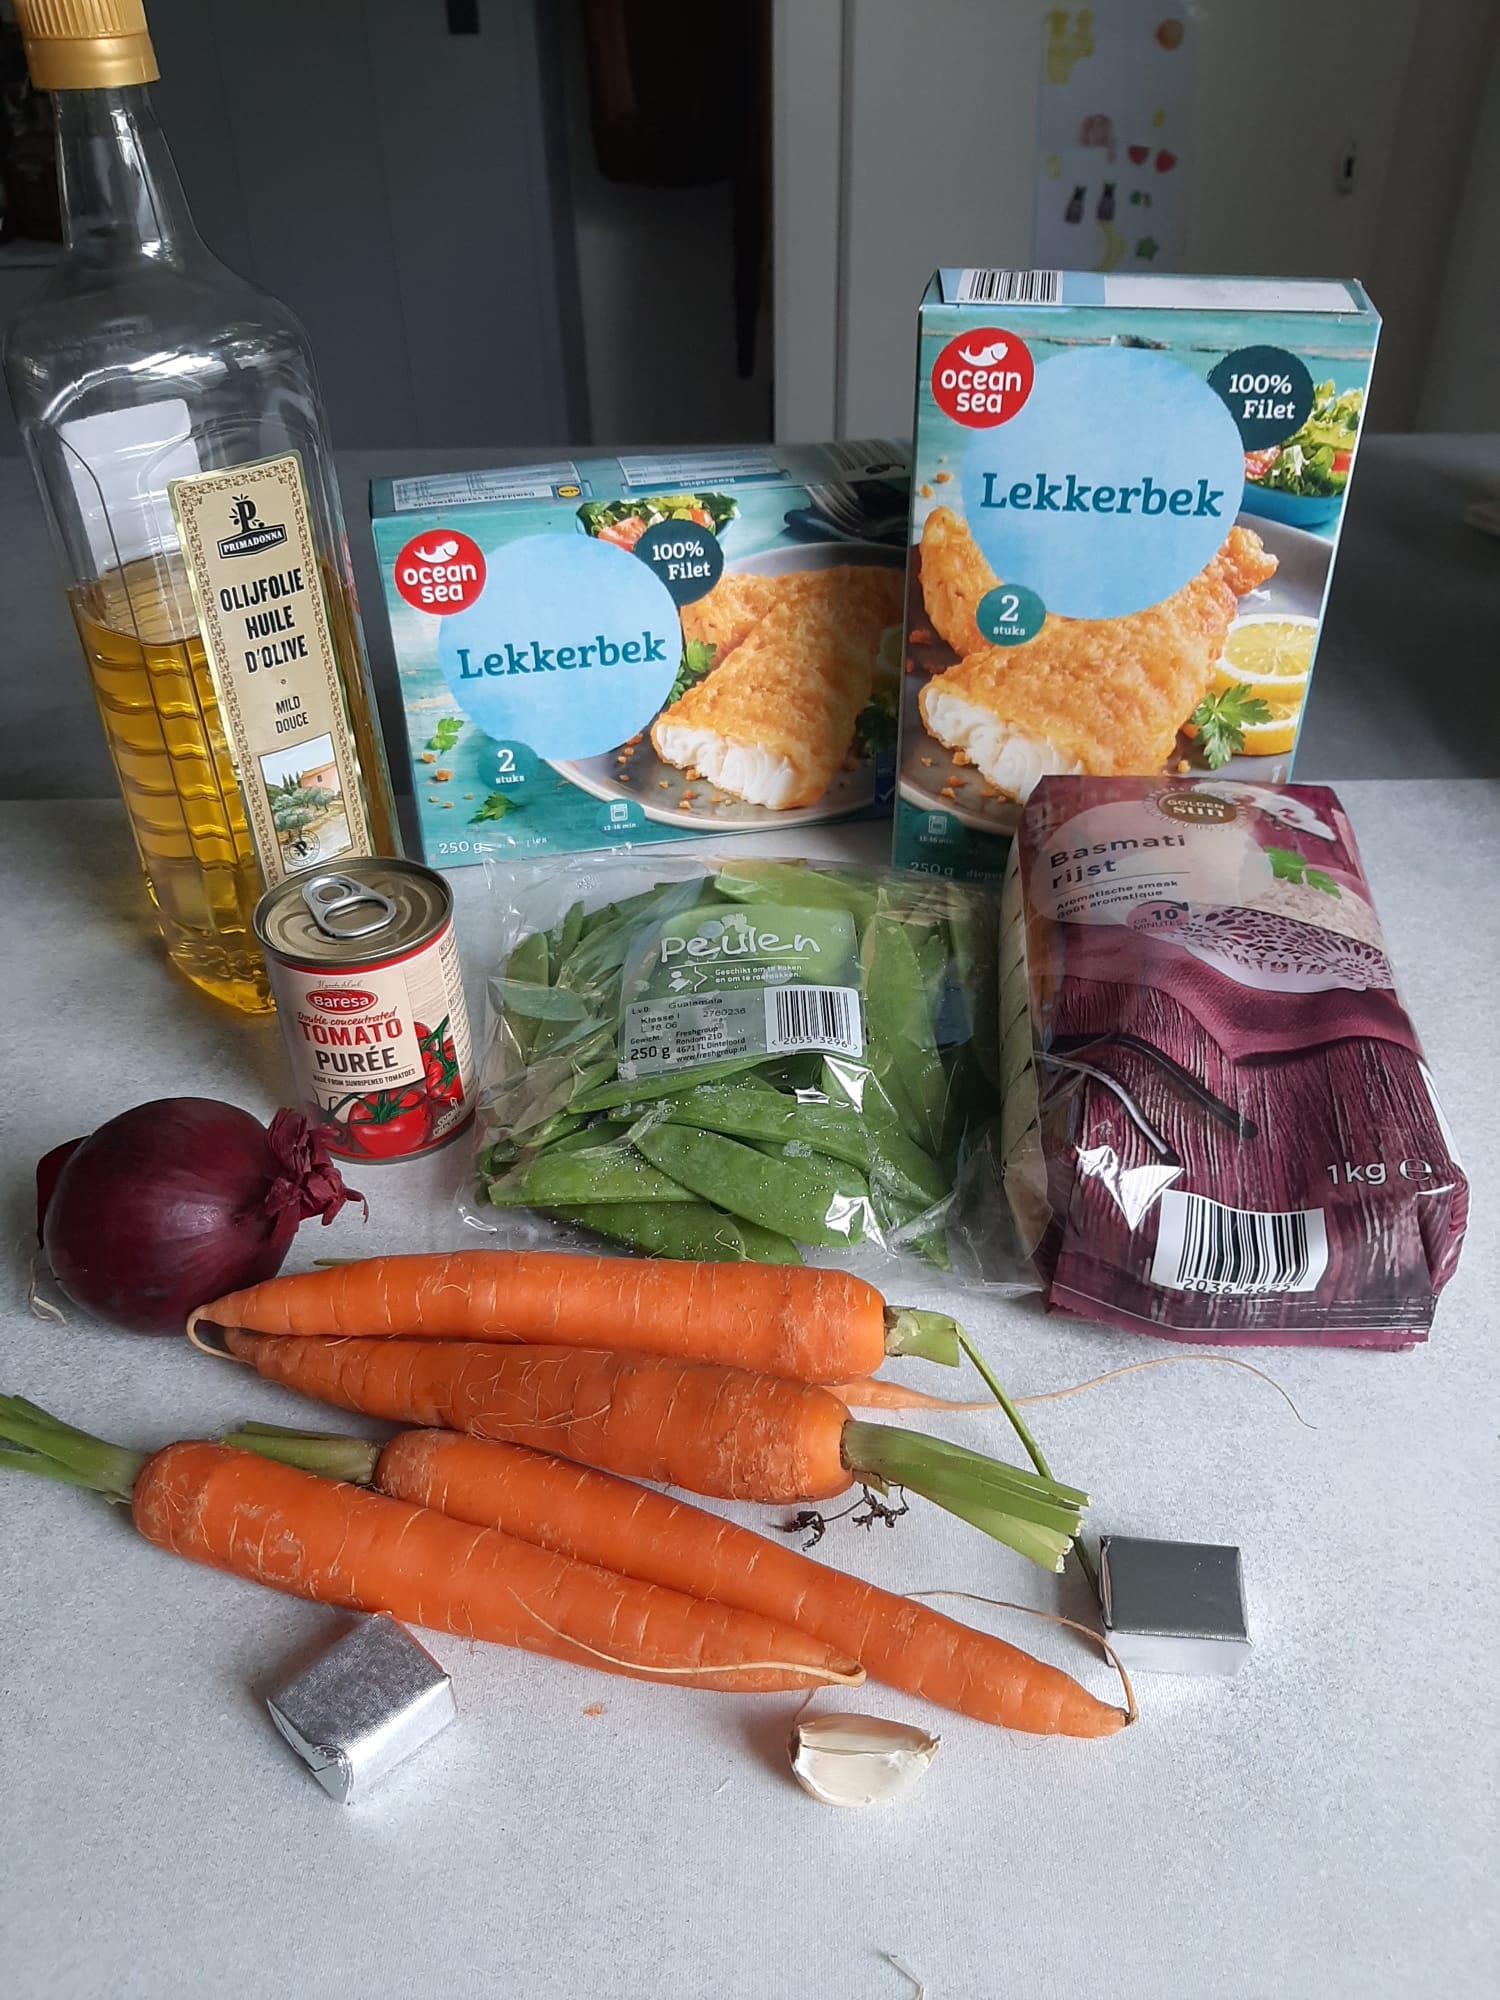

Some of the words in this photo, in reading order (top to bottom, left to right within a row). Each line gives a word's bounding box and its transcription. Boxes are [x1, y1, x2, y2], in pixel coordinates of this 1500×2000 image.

[940, 367, 1022, 393] ocean
[1229, 374, 1293, 395] 100%
[955, 389, 1003, 414] sea
[1242, 399, 1296, 421] Filet
[980, 473, 1225, 517] Lekkerbek
[222, 529, 283, 553] PRIMADONNA
[652, 541, 704, 561] 100%
[403, 562, 477, 586] ocean
[668, 560, 711, 580] Filet
[220, 567, 305, 612] OLIJFOLIE
[421, 581, 464, 604] sea
[999, 595, 1019, 622] 2
[245, 605, 295, 640] HUILE
[992, 624, 1026, 637] stuks
[245, 634, 308, 674] D'OLIVE
[458, 632, 667, 680] Lekkerbek
[275, 696, 301, 716] MILD
[275, 711, 309, 734] DOUCE
[497, 750, 516, 773] 2
[495, 773, 525, 785] stuks
[1167, 800, 1225, 810] GOLDEN
[439, 840, 469, 855] 250
[1050, 834, 1186, 868] Basmati
[1052, 860, 1116, 889] rijst
[1056, 886, 1134, 911] Aromatische
[1137, 880, 1178, 890] smaak
[1089, 891, 1163, 908] aromatique
[1151, 908, 1179, 922] 10
[715, 967, 751, 976] Geschikt
[313, 996, 369, 1008] Baresa
[668, 998, 723, 1009] Guatemala
[330, 1006, 397, 1026] concentrated
[298, 1018, 403, 1047] TOMATO
[676, 1026, 718, 1038] Freshgroup
[708, 1033, 723, 1041] 210
[784, 1036, 813, 1046] 2055
[820, 1037, 848, 1048] 3296
[315, 1045, 399, 1073] PURÉE
[630, 1046, 657, 1061] 250
[662, 1046, 671, 1060] g
[384, 1068, 416, 1083] TOMATOES
[1183, 1278, 1233, 1293] 2036
[1244, 1282, 1291, 1293] 4625
